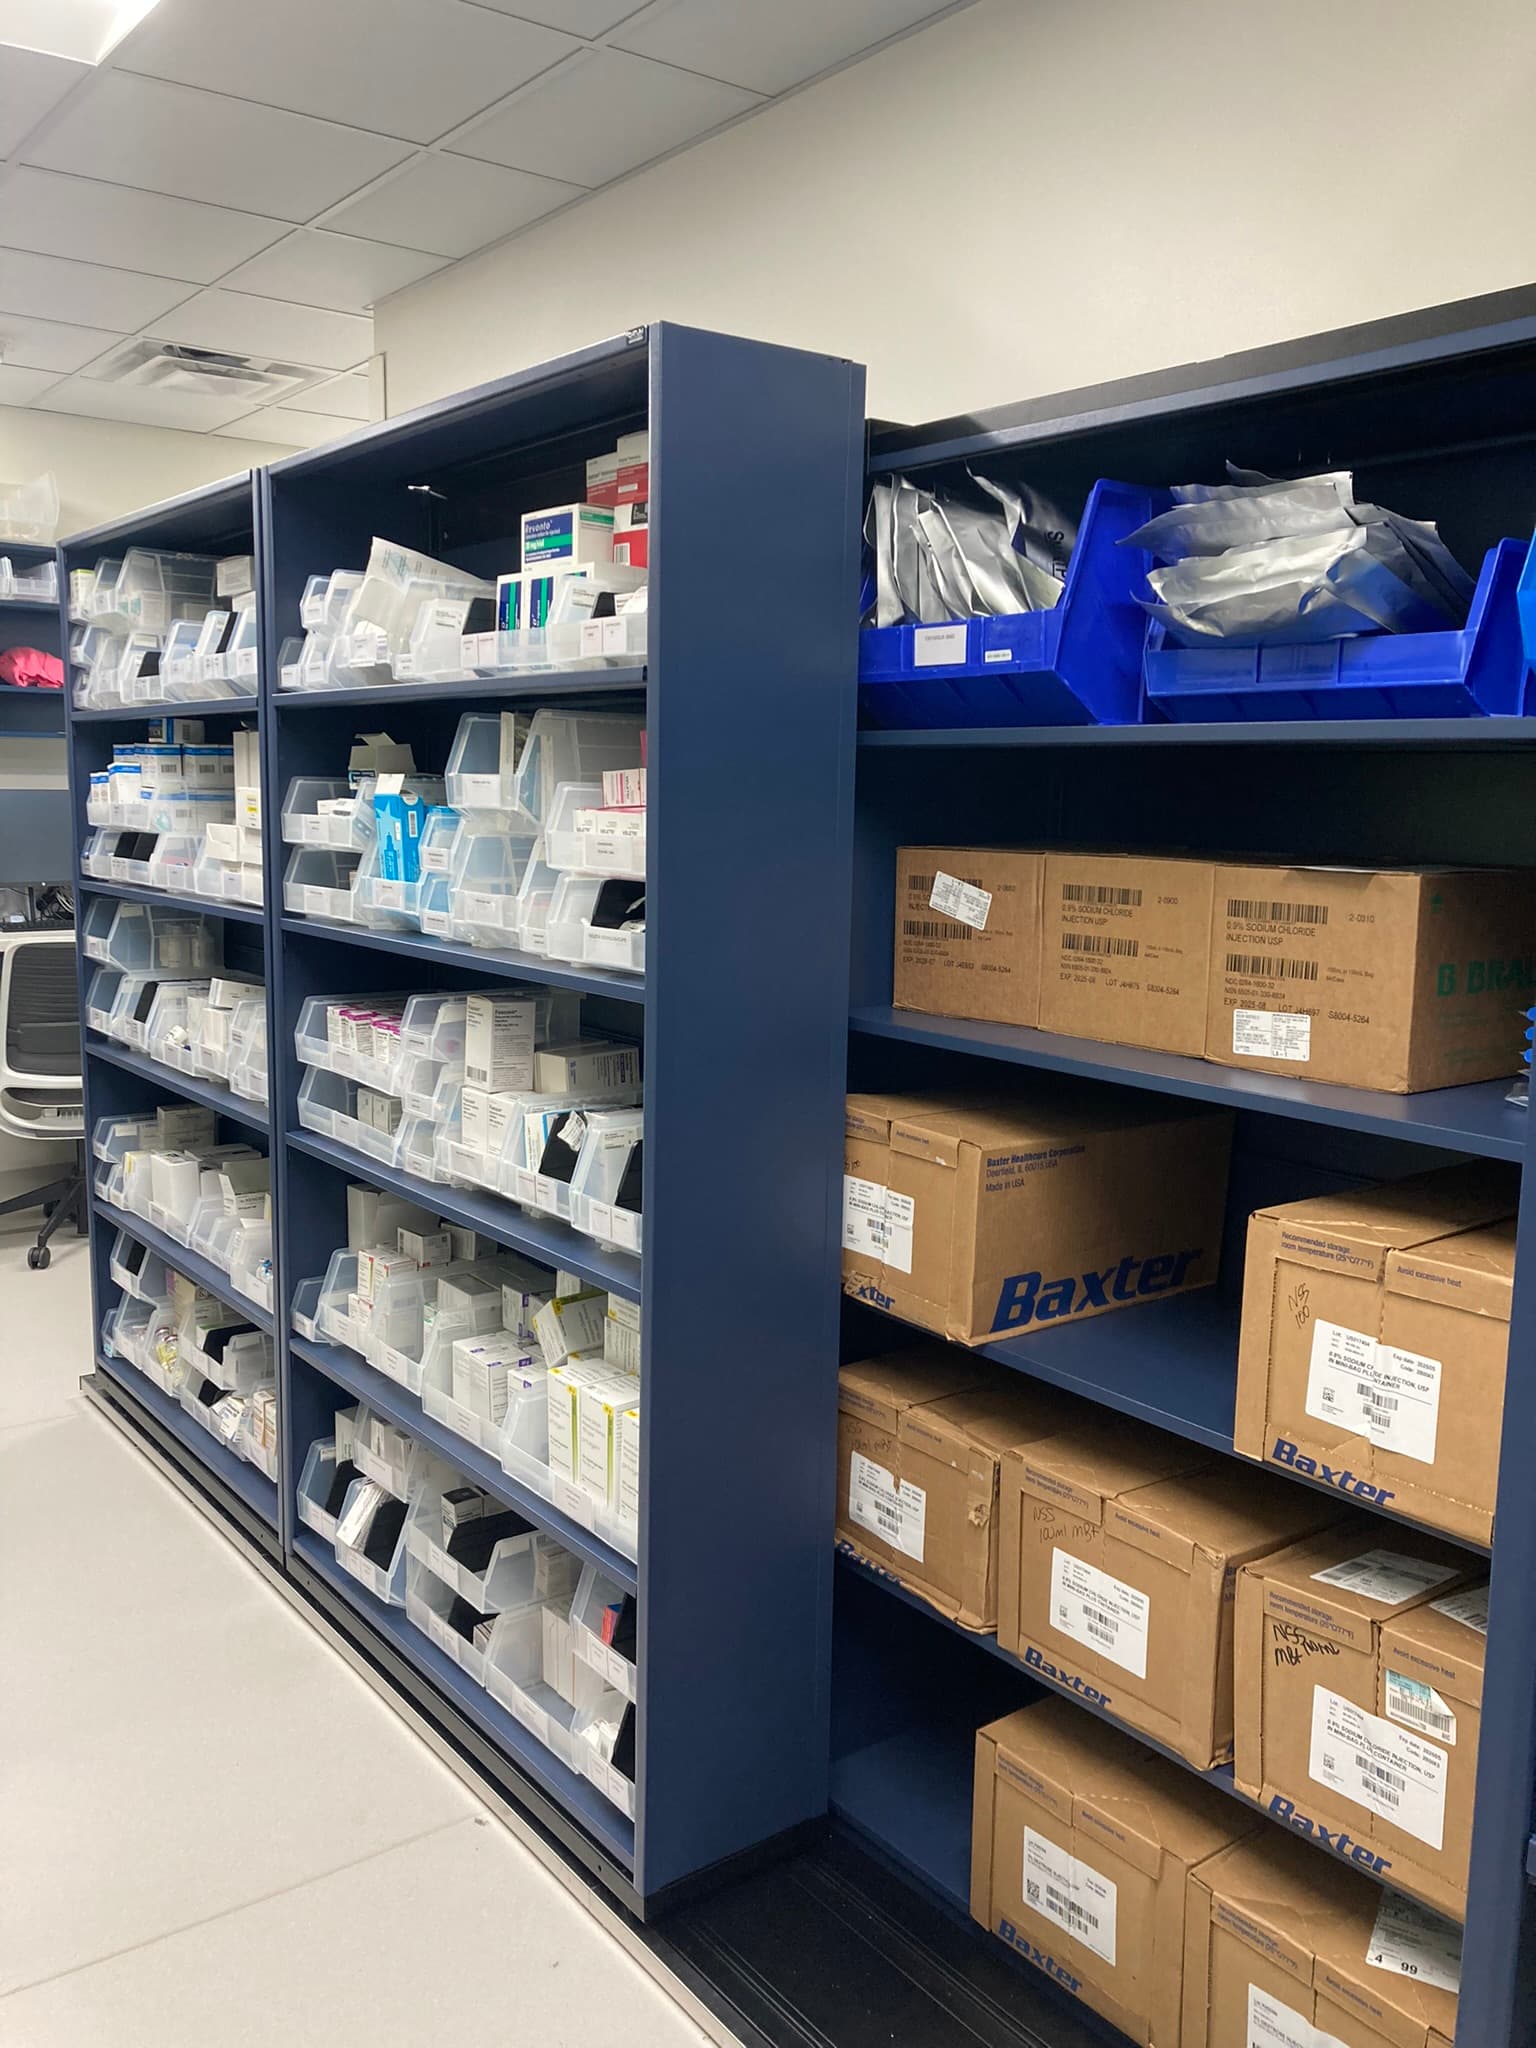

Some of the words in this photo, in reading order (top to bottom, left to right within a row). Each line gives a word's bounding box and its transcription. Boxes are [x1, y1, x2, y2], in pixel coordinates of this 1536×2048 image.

[1062, 915, 1094, 924] INJECTION
[1094, 918, 1108, 926] USP
[1078, 905, 1102, 915] SODIUM
[1104, 908, 1133, 918] CHLORIDE
[1226, 921, 1244, 930] 0.9%
[1246, 922, 1277, 934] SODIUM
[1278, 925, 1316, 937] CHLORIDE
[1226, 934, 1267, 944] INJECTION
[1268, 936, 1284, 946] USP
[1106, 978, 1118, 986] LOT
[1437, 963, 1456, 996] B
[1224, 997, 1237, 1006] EXP
[1278, 1004, 1293, 1014] LOT
[987, 1156, 1010, 1168] Baxter
[1011, 1150, 1048, 1164] Healthcare
[986, 1182, 1003, 1192] Made
[1004, 1181, 1011, 1189] in
[1012, 1178, 1024, 1188] USA
[1282, 1231, 1326, 1248] Recommended
[1281, 1242, 1296, 1251] room
[1298, 1244, 1334, 1260] temperature
[1397, 1265, 1414, 1277] Avoid
[1415, 1270, 1446, 1284] excessive
[1447, 1276, 1462, 1288] heat
[989, 1252, 1202, 1334] Baxter
[1343, 1354, 1366, 1368] SODIUM
[1417, 1384, 1430, 1392] USP
[1271, 1438, 1396, 1506] Baxter
[1033, 1506, 1056, 1523] NSS
[1269, 1590, 1311, 1614] Recommended
[1285, 1606, 1318, 1626] temperature
[1393, 1646, 1410, 1659] Avoid
[1410, 1652, 1440, 1672] excessive
[1441, 1666, 1456, 1680] heat
[1025, 1644, 1112, 1708] Baxter
[1341, 1724, 1363, 1740] SODIUM
[1424, 1770, 1436, 1780] USP
[1374, 1750, 1407, 1772] CONTAINER
[1269, 1794, 1393, 1874] Baxter
[998, 1918, 1083, 1993] Baxter
[1374, 1954, 1383, 1964] 4
[1401, 1962, 1418, 1976] 99
